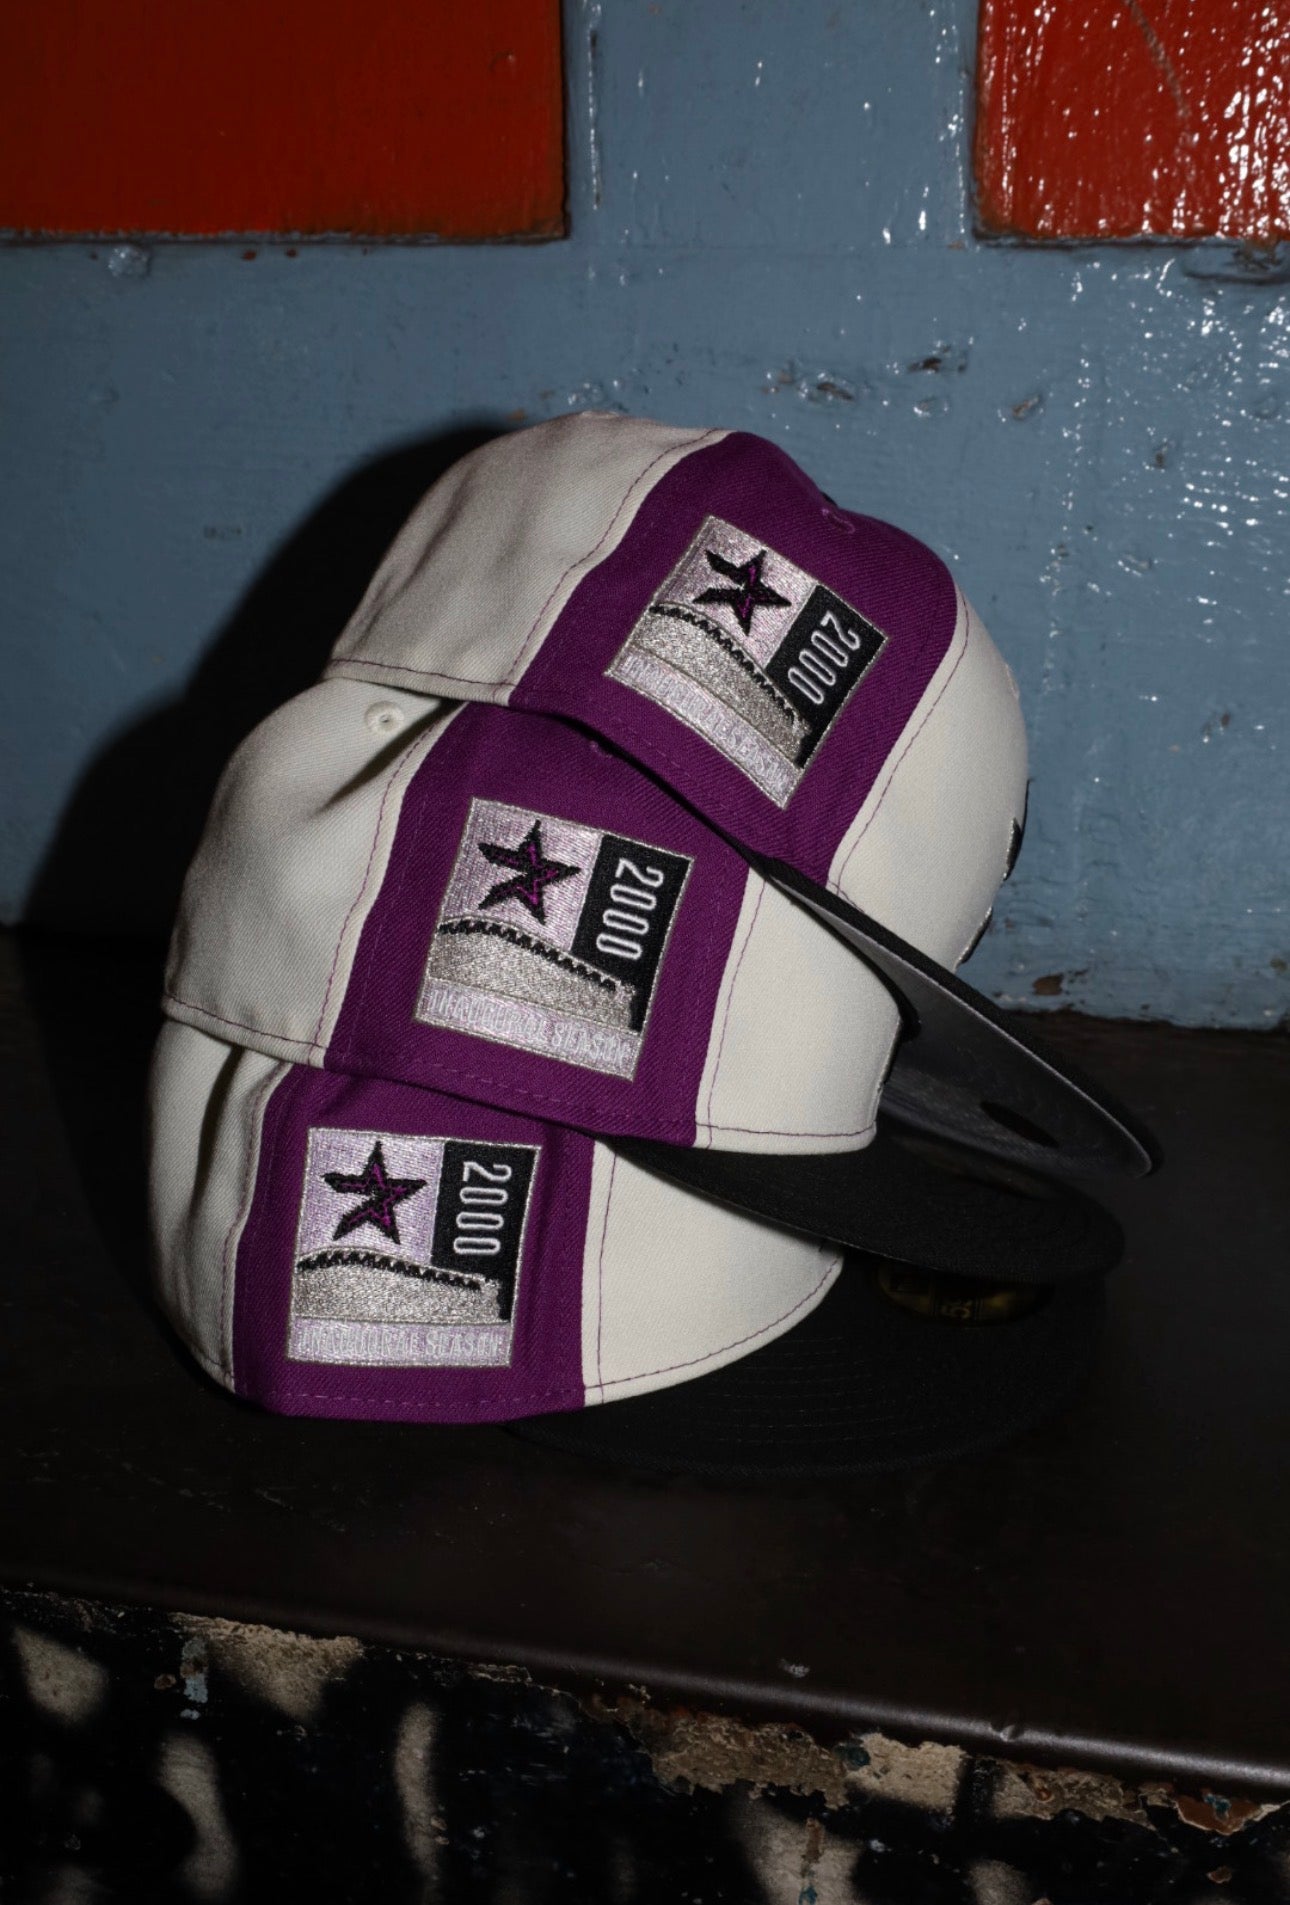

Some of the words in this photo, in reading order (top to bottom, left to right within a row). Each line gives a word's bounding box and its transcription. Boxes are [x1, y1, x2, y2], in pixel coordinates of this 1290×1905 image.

[788, 610, 861, 705] 2000
[596, 857, 665, 960] 2000
[551, 1020, 631, 1066] SEASON
[453, 1161, 513, 1256] 2000
[426, 1331, 500, 1357] SEASON
